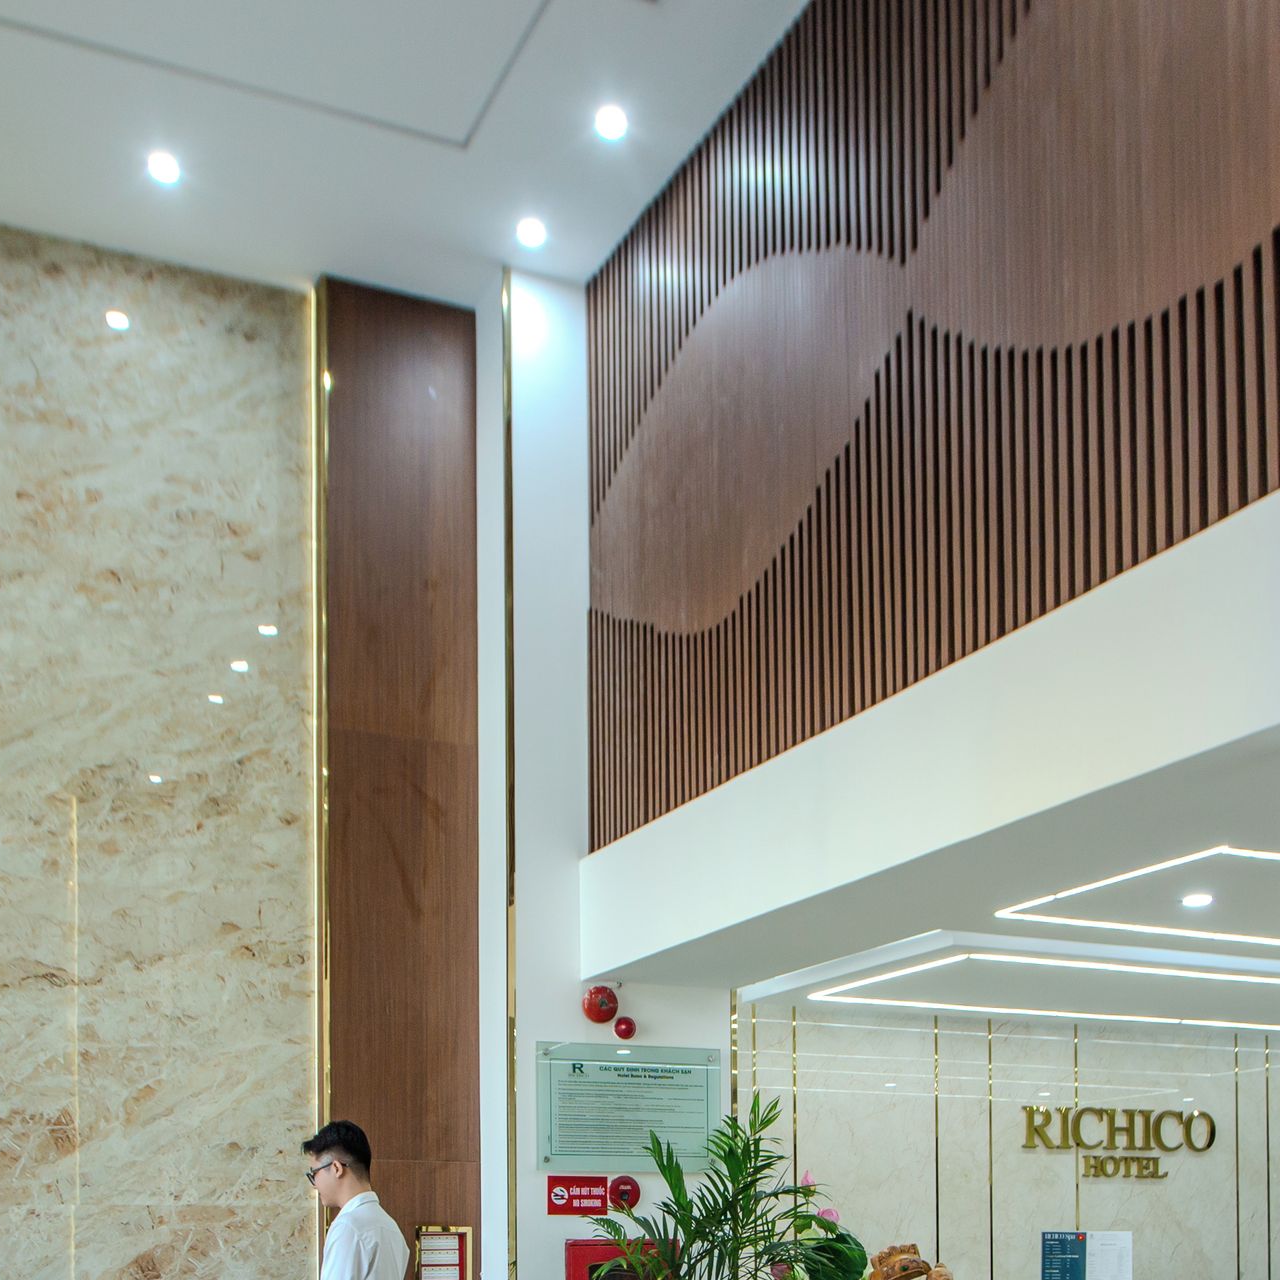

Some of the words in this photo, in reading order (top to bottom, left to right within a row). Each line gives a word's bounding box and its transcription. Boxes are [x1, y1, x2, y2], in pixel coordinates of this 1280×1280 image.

[572, 1063, 584, 1074] R
[1021, 1105, 1216, 1153] RICHICO
[1082, 1155, 1168, 1179] HOTEL
[581, 1199, 602, 1207] SMOKING
